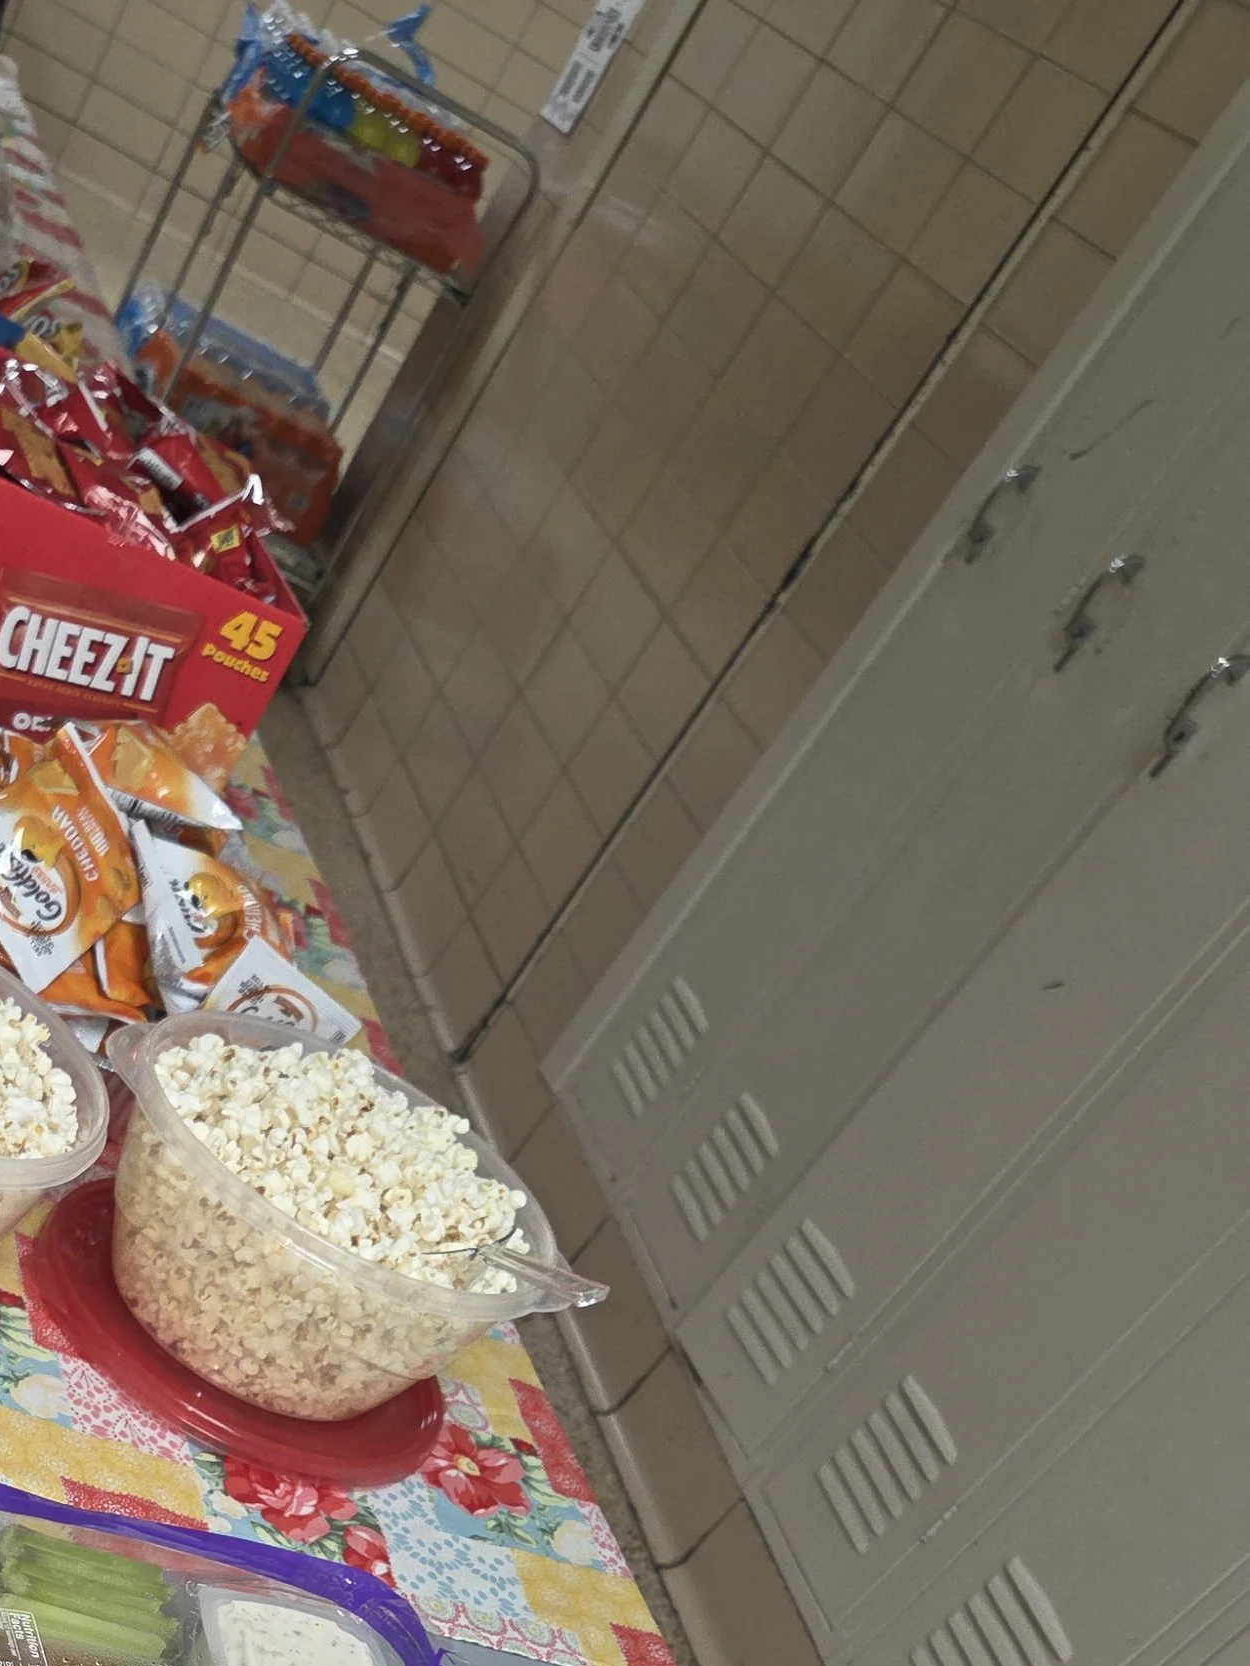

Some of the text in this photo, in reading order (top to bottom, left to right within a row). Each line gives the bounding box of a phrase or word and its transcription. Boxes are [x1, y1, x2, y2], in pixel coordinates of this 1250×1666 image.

[219, 610, 283, 661] 45
[51, 803, 99, 882] CHEDDAR
[9, 1612, 25, 1640] Facts
[19, 1613, 40, 1658] Nutrition
